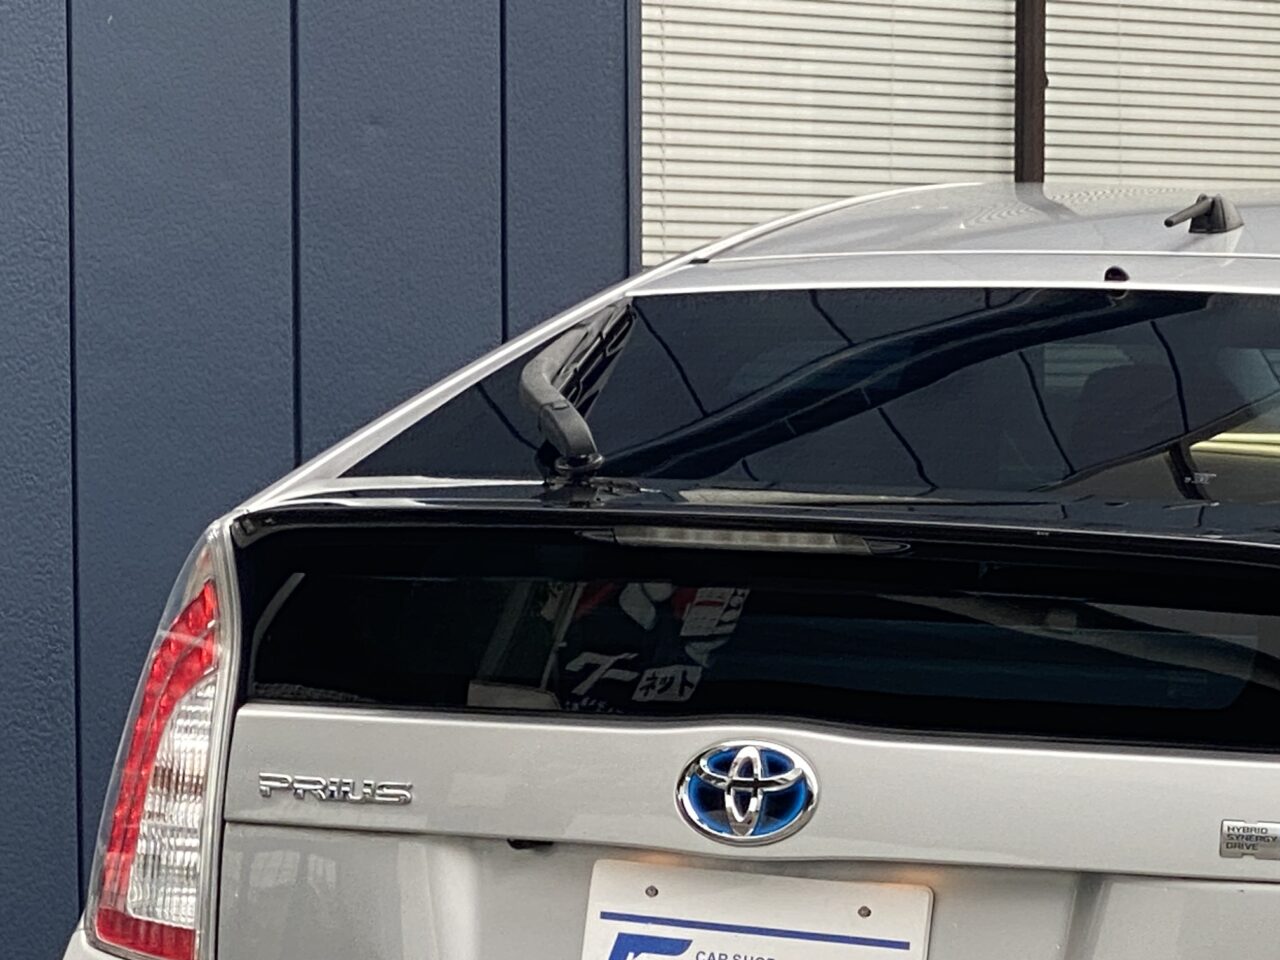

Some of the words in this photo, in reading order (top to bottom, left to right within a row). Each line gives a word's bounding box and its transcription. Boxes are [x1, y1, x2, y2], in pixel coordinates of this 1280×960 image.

[258, 771, 413, 804] PRIUS
[1227, 826, 1268, 834] HYBRID
[1226, 834, 1278, 842] SYNERGY
[1226, 842, 1258, 850] DRIVE
